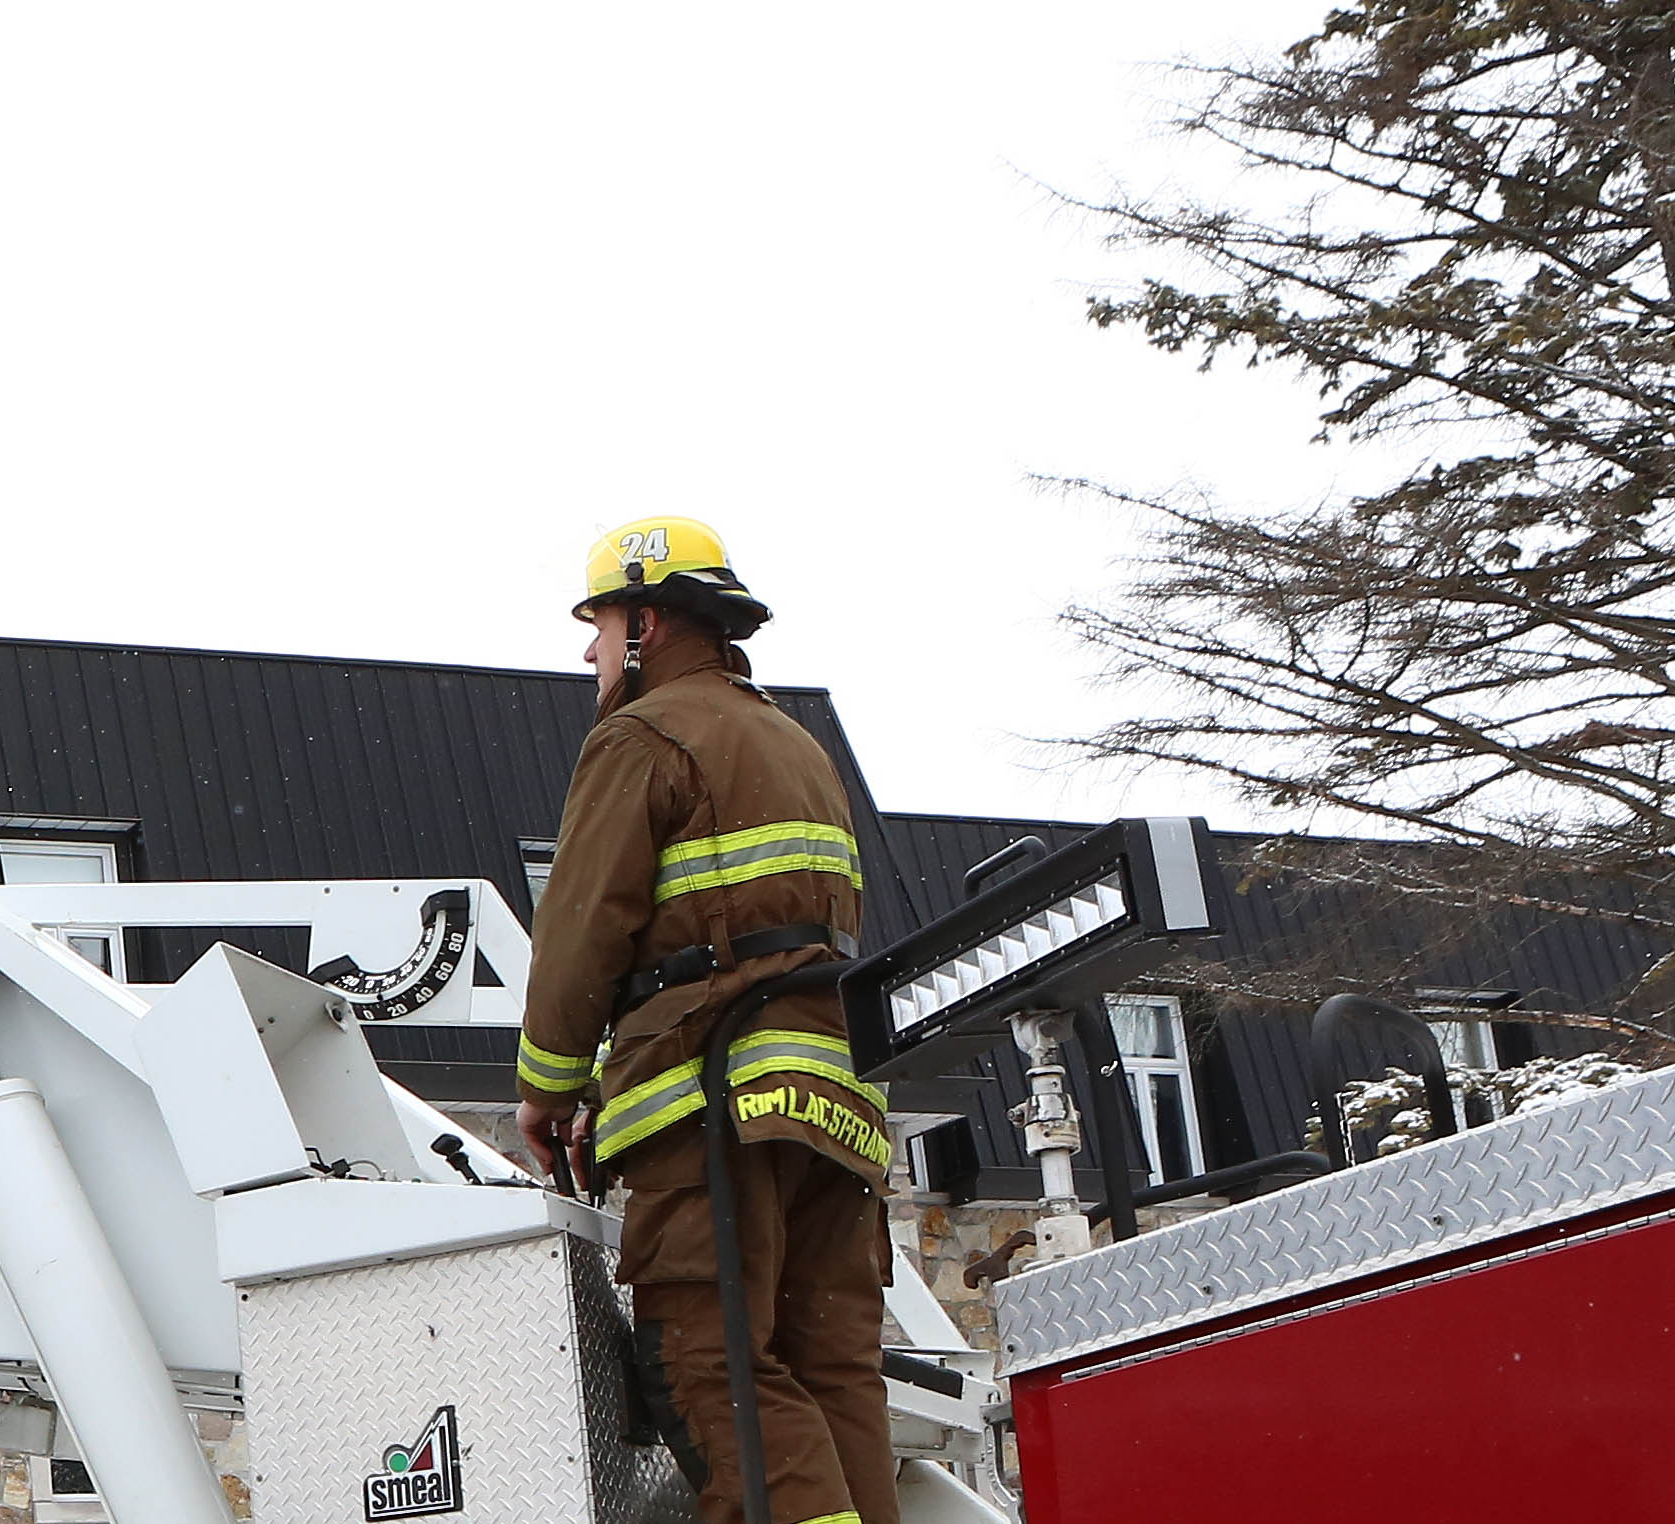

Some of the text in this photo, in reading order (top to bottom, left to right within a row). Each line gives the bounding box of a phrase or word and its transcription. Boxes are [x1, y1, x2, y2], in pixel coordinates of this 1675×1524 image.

[619, 528, 669, 568] 24
[448, 932, 465, 953] 80
[434, 961, 454, 981] 60
[415, 986, 435, 1004] 40
[362, 1009, 375, 1020] 0
[386, 1003, 409, 1018] 20
[736, 1085, 786, 1122] RIM
[786, 1085, 832, 1129] LAC
